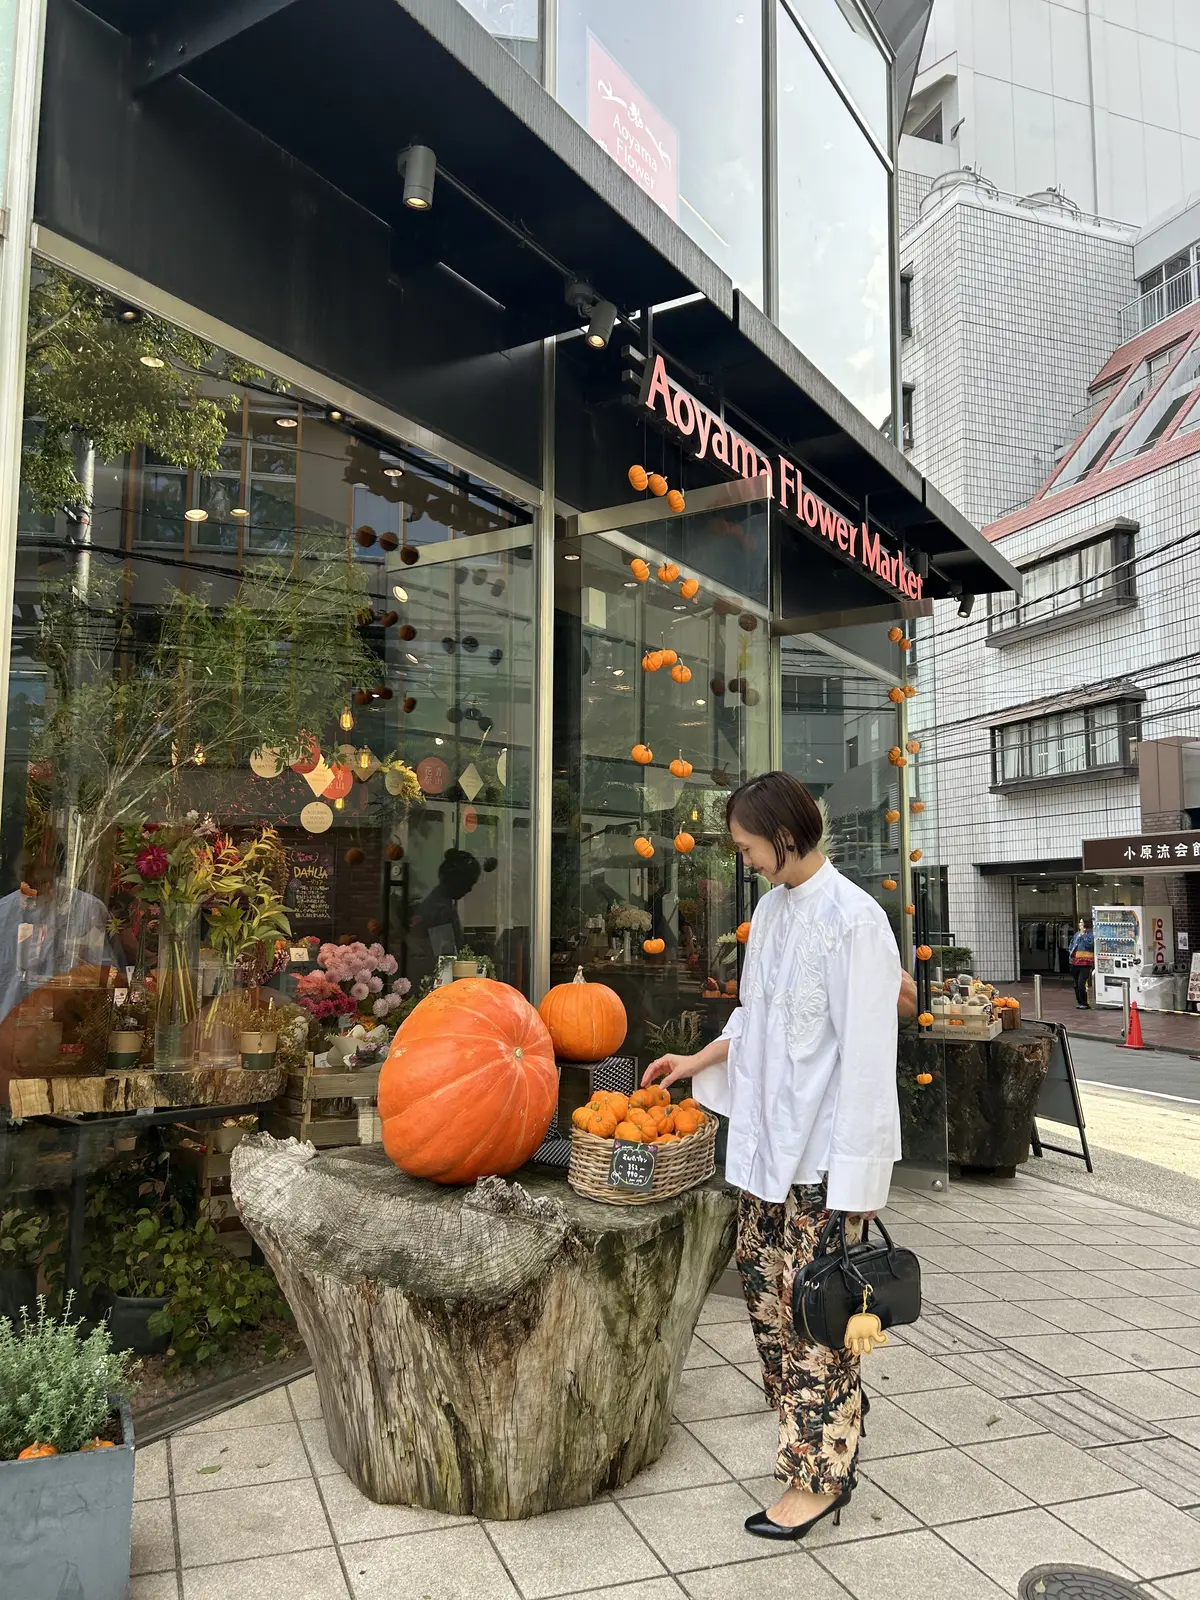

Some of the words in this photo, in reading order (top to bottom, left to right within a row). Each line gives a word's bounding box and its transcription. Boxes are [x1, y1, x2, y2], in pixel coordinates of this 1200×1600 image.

[613, 113, 658, 172] Aoyama
[616, 135, 655, 190] Flower
[778, 454, 858, 558] Flower
[861, 522, 924, 600] Market
[293, 865, 329, 879] DAHLIA
